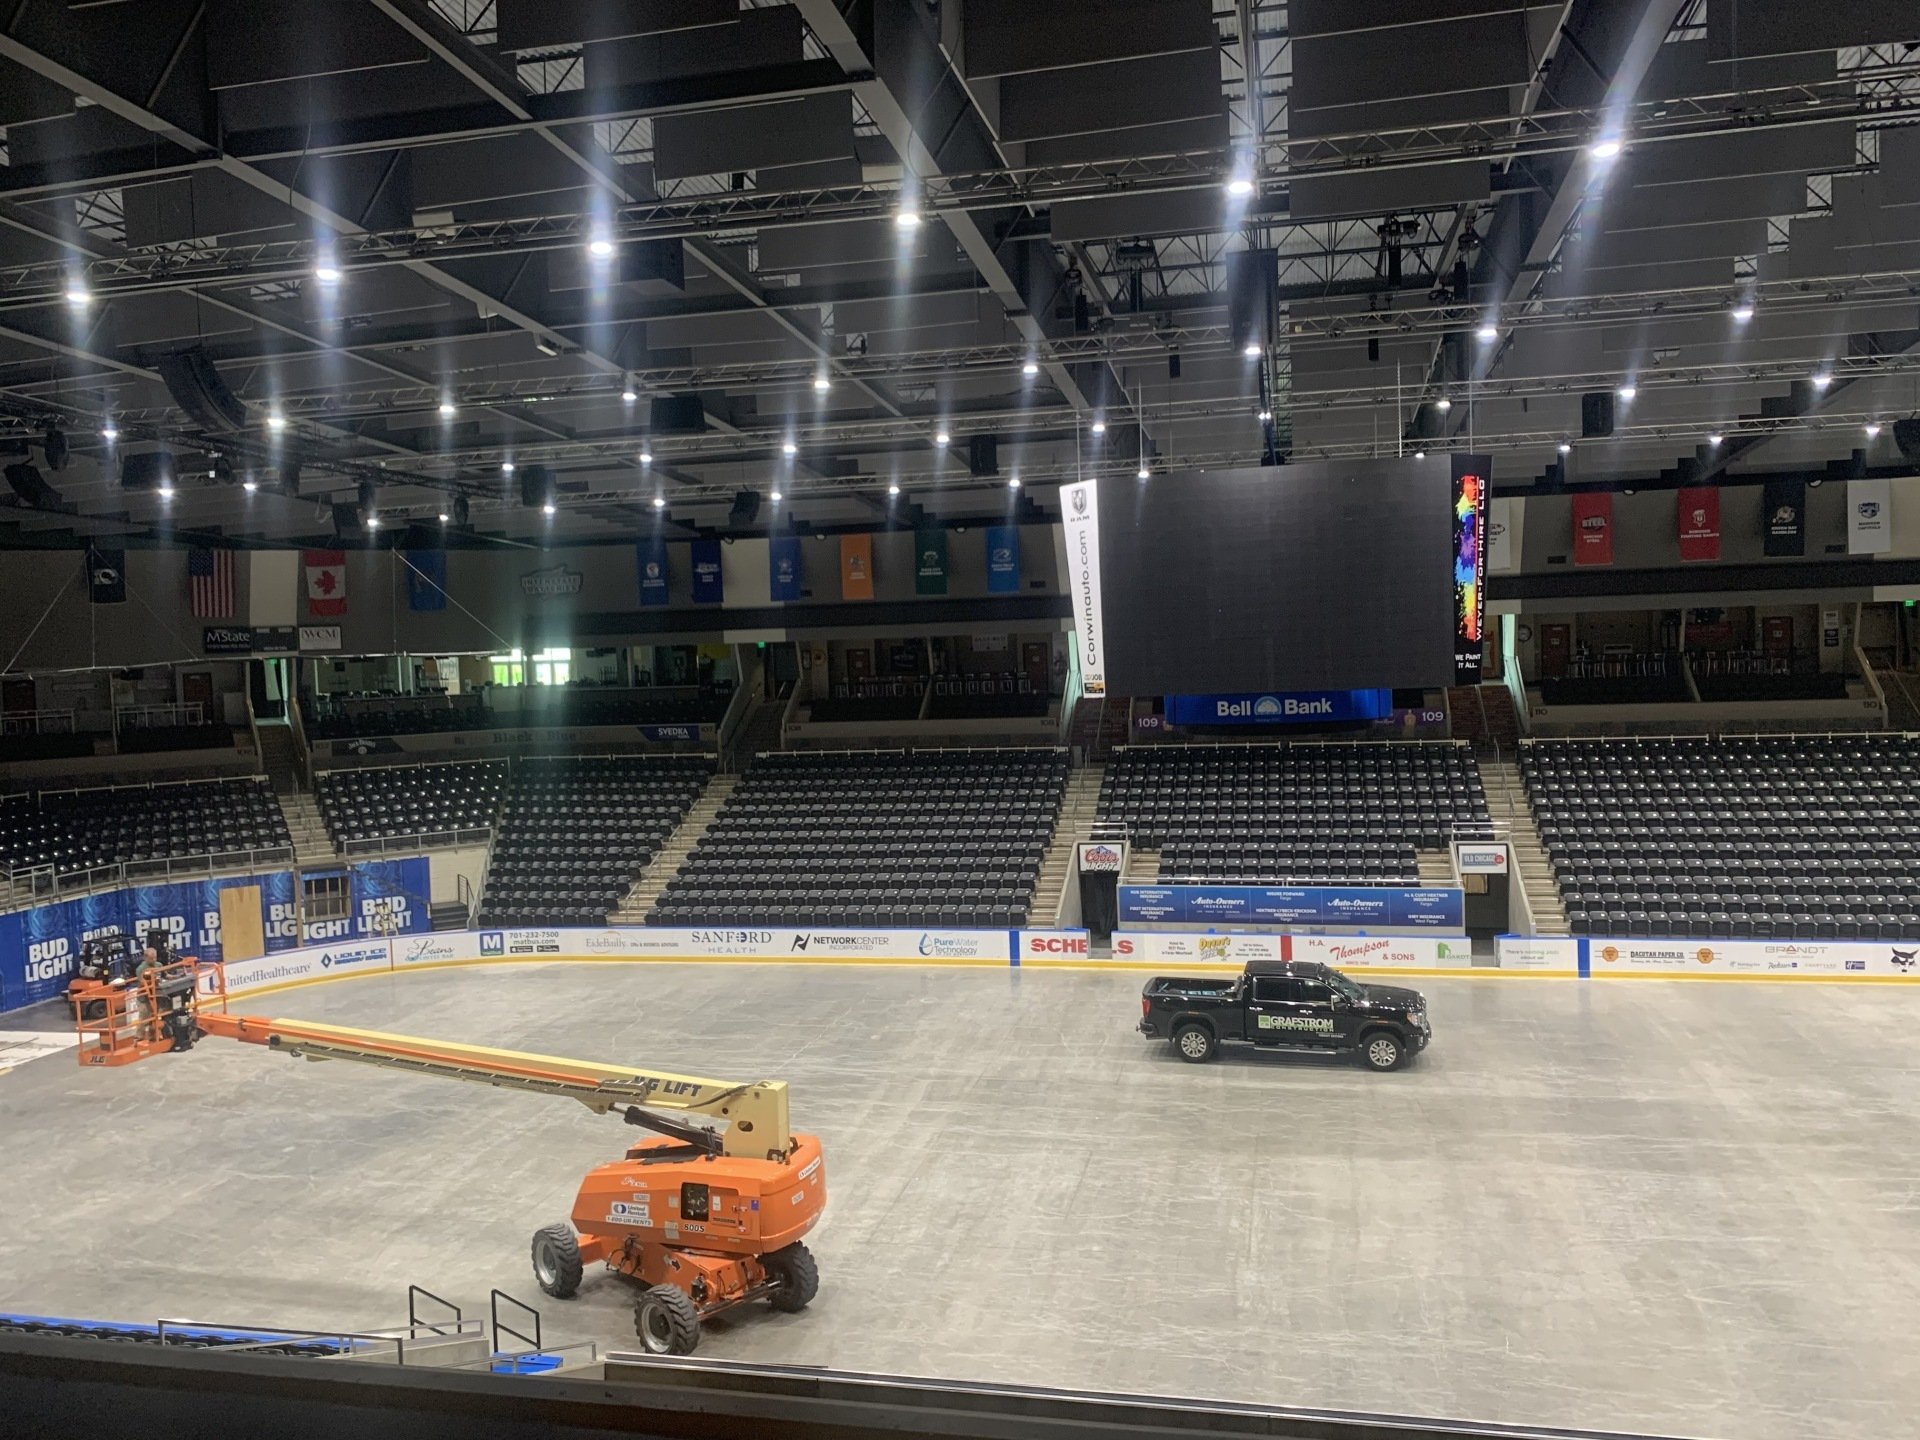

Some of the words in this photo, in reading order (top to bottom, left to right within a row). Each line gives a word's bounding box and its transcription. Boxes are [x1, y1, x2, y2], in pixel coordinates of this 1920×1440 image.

[1079, 529, 1097, 666] Corwinauto.com
[1217, 700, 1251, 716] Bell
[1284, 698, 1332, 715] Bank
[1137, 717, 1159, 728] 109
[1421, 711, 1445, 722] 109
[658, 727, 689, 737] SVEDKA
[1085, 848, 1120, 863] Coors
[1087, 861, 1118, 871] LIGHT
[361, 896, 407, 916] BUD
[1191, 897, 1245, 905] Auto-Owners
[1327, 898, 1384, 907] Auto-Owners
[269, 902, 297, 921] BU
[265, 919, 298, 938] LIG
[303, 918, 351, 940] IGHT
[357, 910, 412, 933] LIGHT
[483, 934, 501, 949] M
[509, 931, 559, 939] 701-232-7500
[691, 931, 772, 944] SANFORD
[28, 937, 69, 963] BUD
[934, 945, 978, 955] Technology
[1308, 939, 1325, 947] H.A.
[1329, 939, 1391, 961] Thompson
[1764, 944, 1829, 955] BRANDT
[1382, 953, 1388, 961] &
[1391, 953, 1416, 961] SONS
[24, 952, 74, 983] LIGHT
[663, 1080, 702, 1097] LIFT
